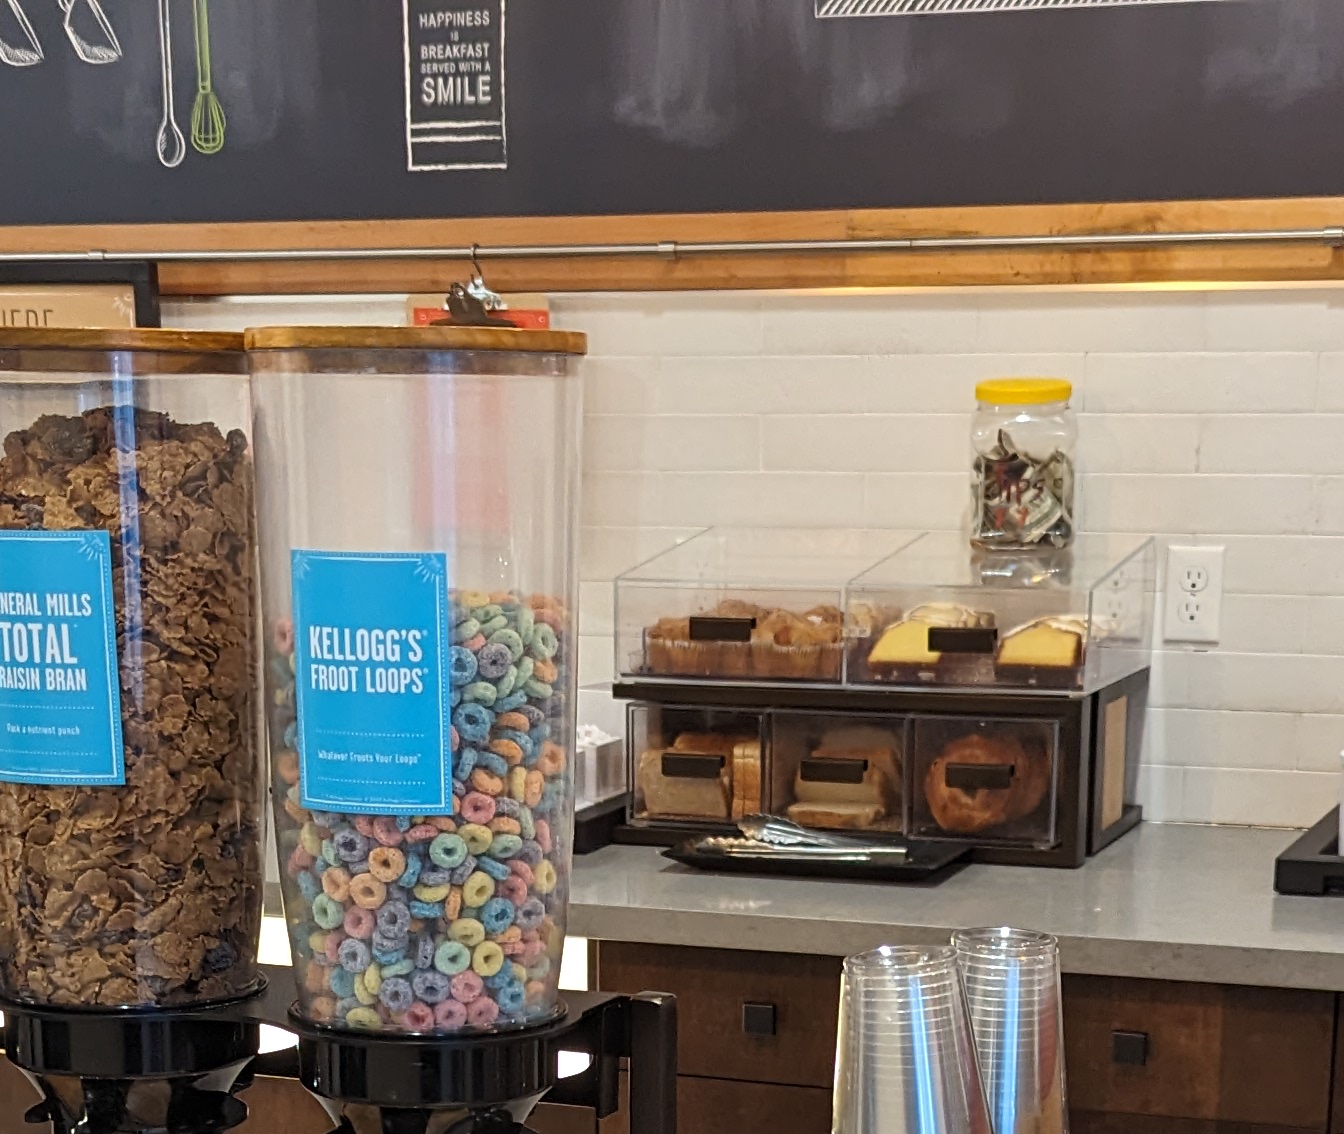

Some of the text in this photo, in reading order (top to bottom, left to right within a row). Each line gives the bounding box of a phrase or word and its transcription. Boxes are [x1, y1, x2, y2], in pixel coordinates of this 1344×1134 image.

[419, 11, 490, 28] HAPPINESS
[450, 31, 459, 41] IS
[420, 43, 490, 59] BREAKFAST
[421, 61, 491, 74] SERVED WITH A
[422, 75, 492, 106] SMILE
[46, 592, 92, 617] MILLS
[46, 668, 87, 691] BRAN
[310, 664, 358, 692] FROOT
[58, 726, 80, 736] punch
